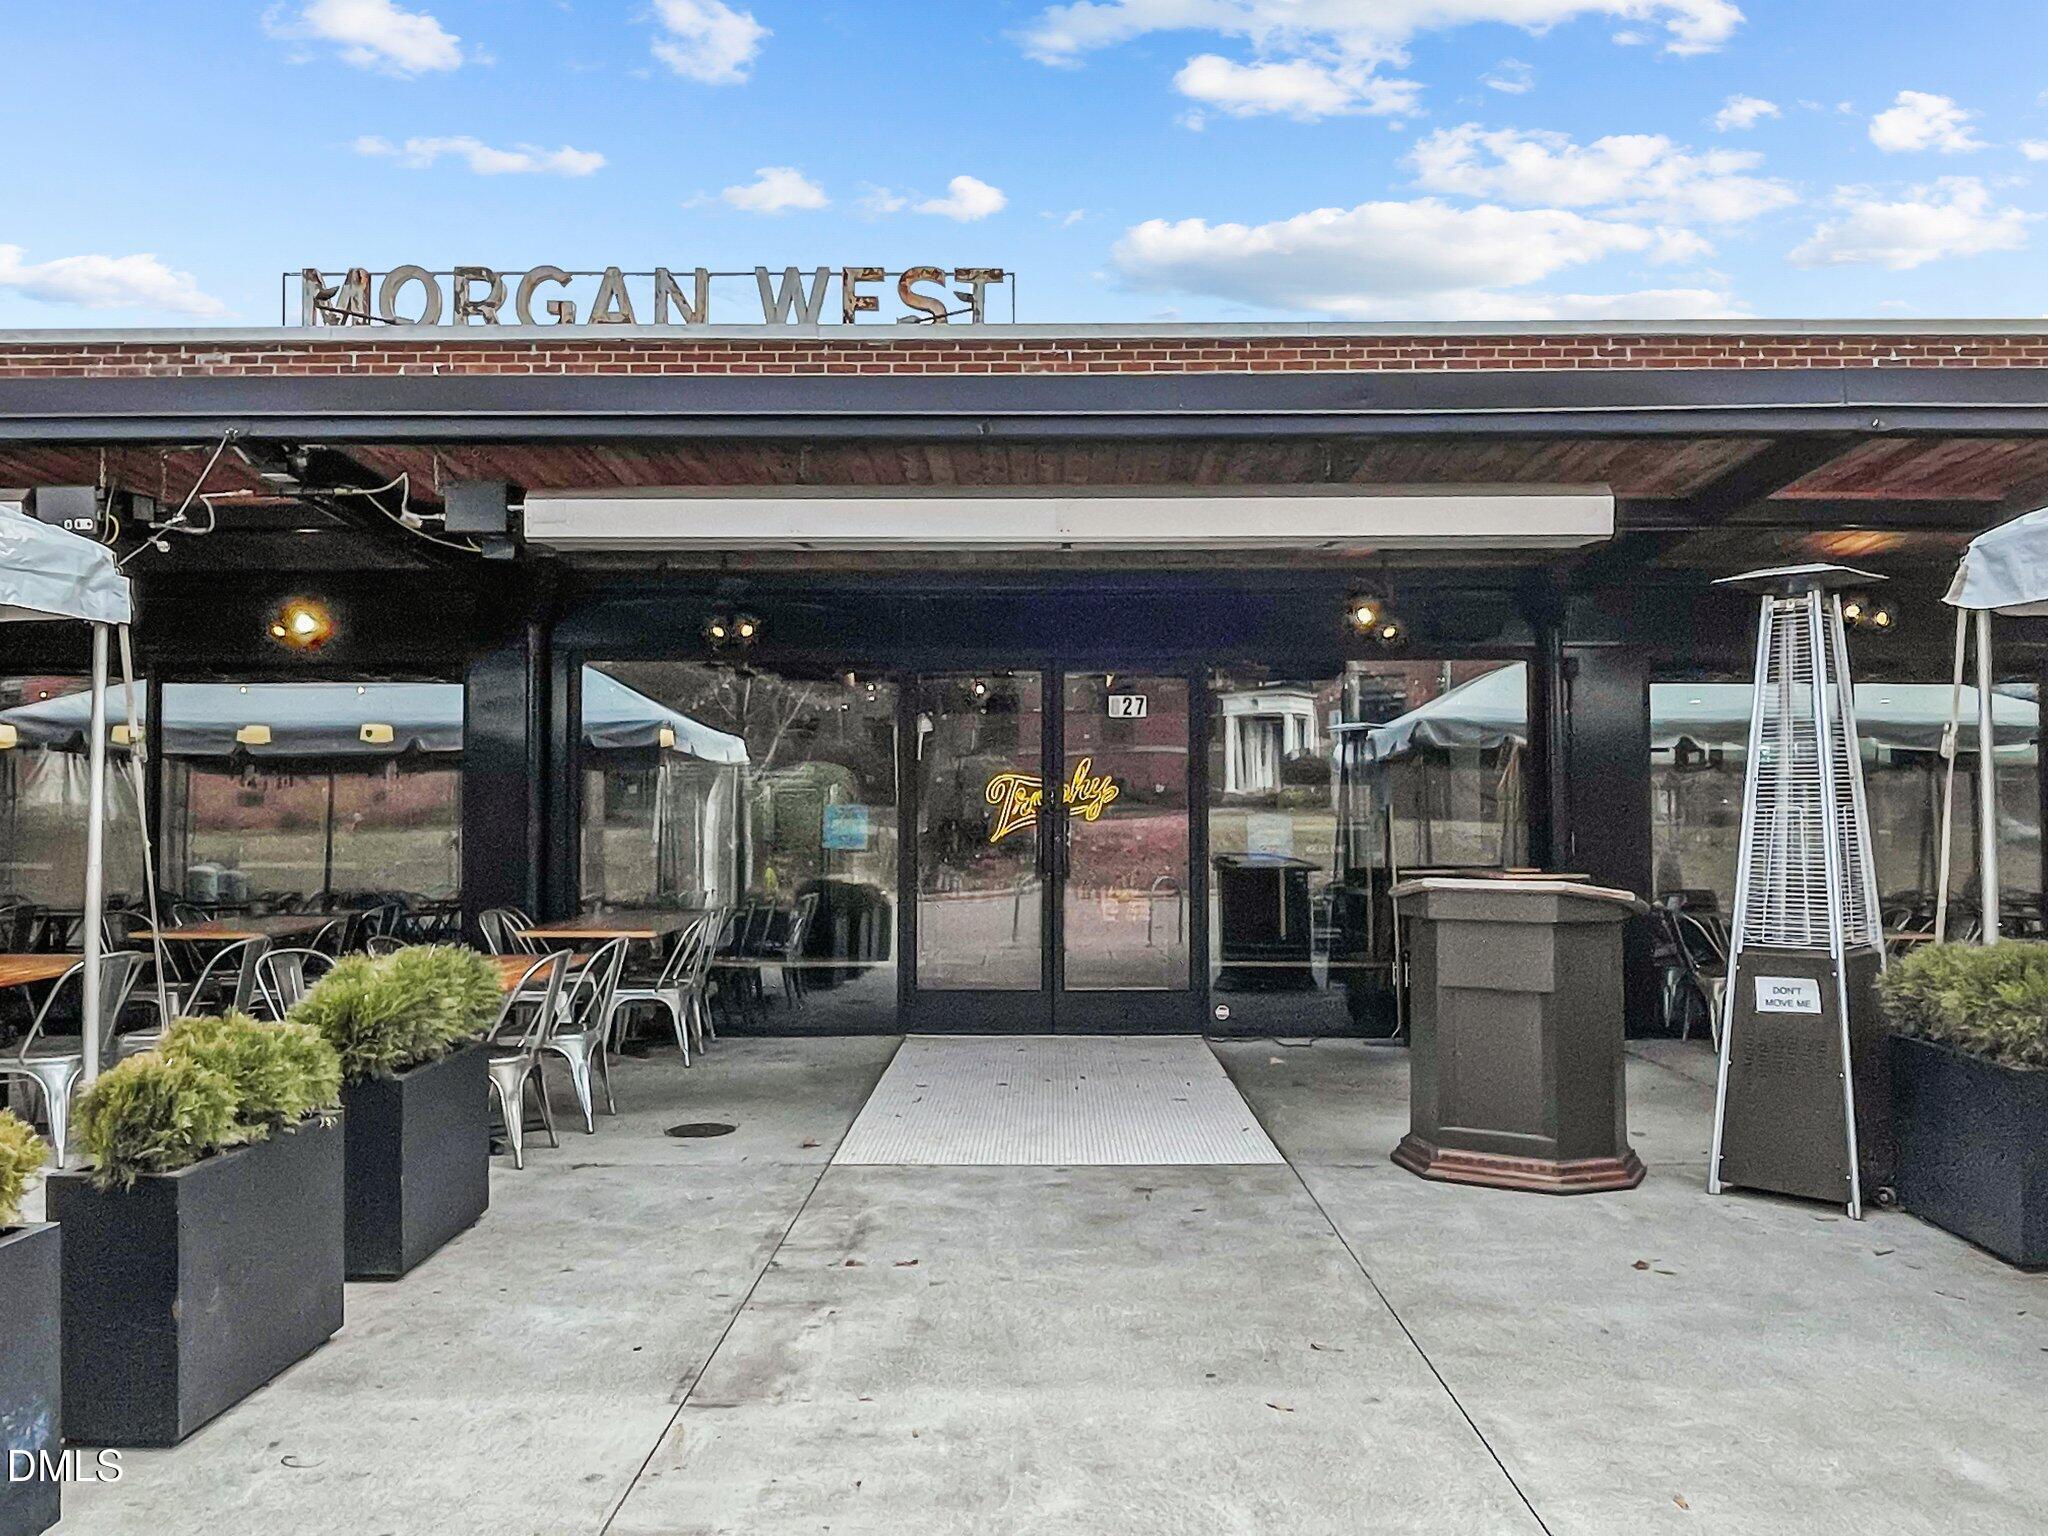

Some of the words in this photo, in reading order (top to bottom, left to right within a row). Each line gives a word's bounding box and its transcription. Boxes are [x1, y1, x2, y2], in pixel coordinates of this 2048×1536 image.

[302, 264, 710, 326] MORGAN
[754, 265, 1004, 326] WEST
[1122, 697, 1145, 716] 27
[1772, 986, 1802, 995] DON'T
[1765, 998, 1794, 1007] MOVE
[1796, 999, 1812, 1008] ME
